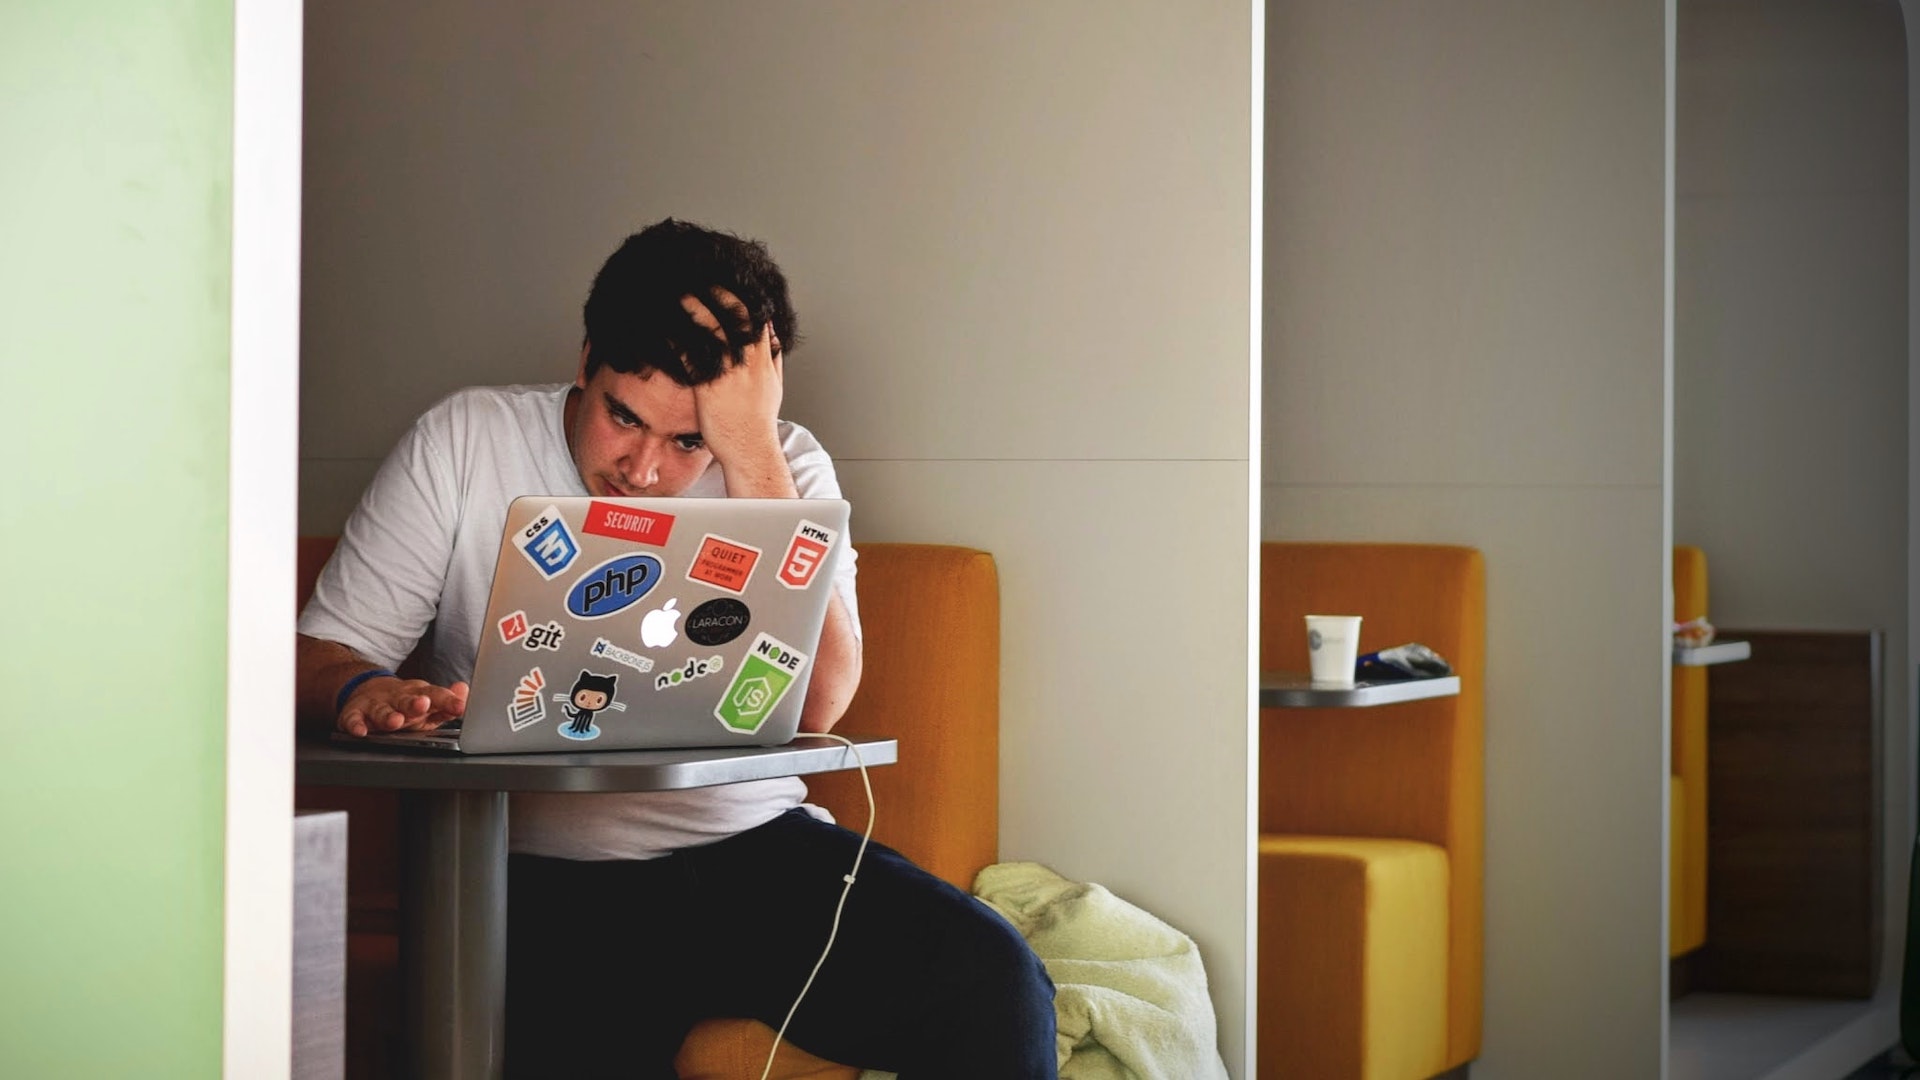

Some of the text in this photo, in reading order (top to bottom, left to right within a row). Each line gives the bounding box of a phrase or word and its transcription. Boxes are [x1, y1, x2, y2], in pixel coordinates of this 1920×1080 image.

[525, 516, 549, 538] CSS
[604, 510, 656, 534] SECURITY
[801, 525, 829, 543] HTML
[711, 547, 746, 564] QUIET
[787, 545, 819, 578] 5
[583, 563, 648, 613] php
[692, 615, 743, 629] LARACON
[525, 624, 562, 648] git
[756, 640, 800, 670] NODE
